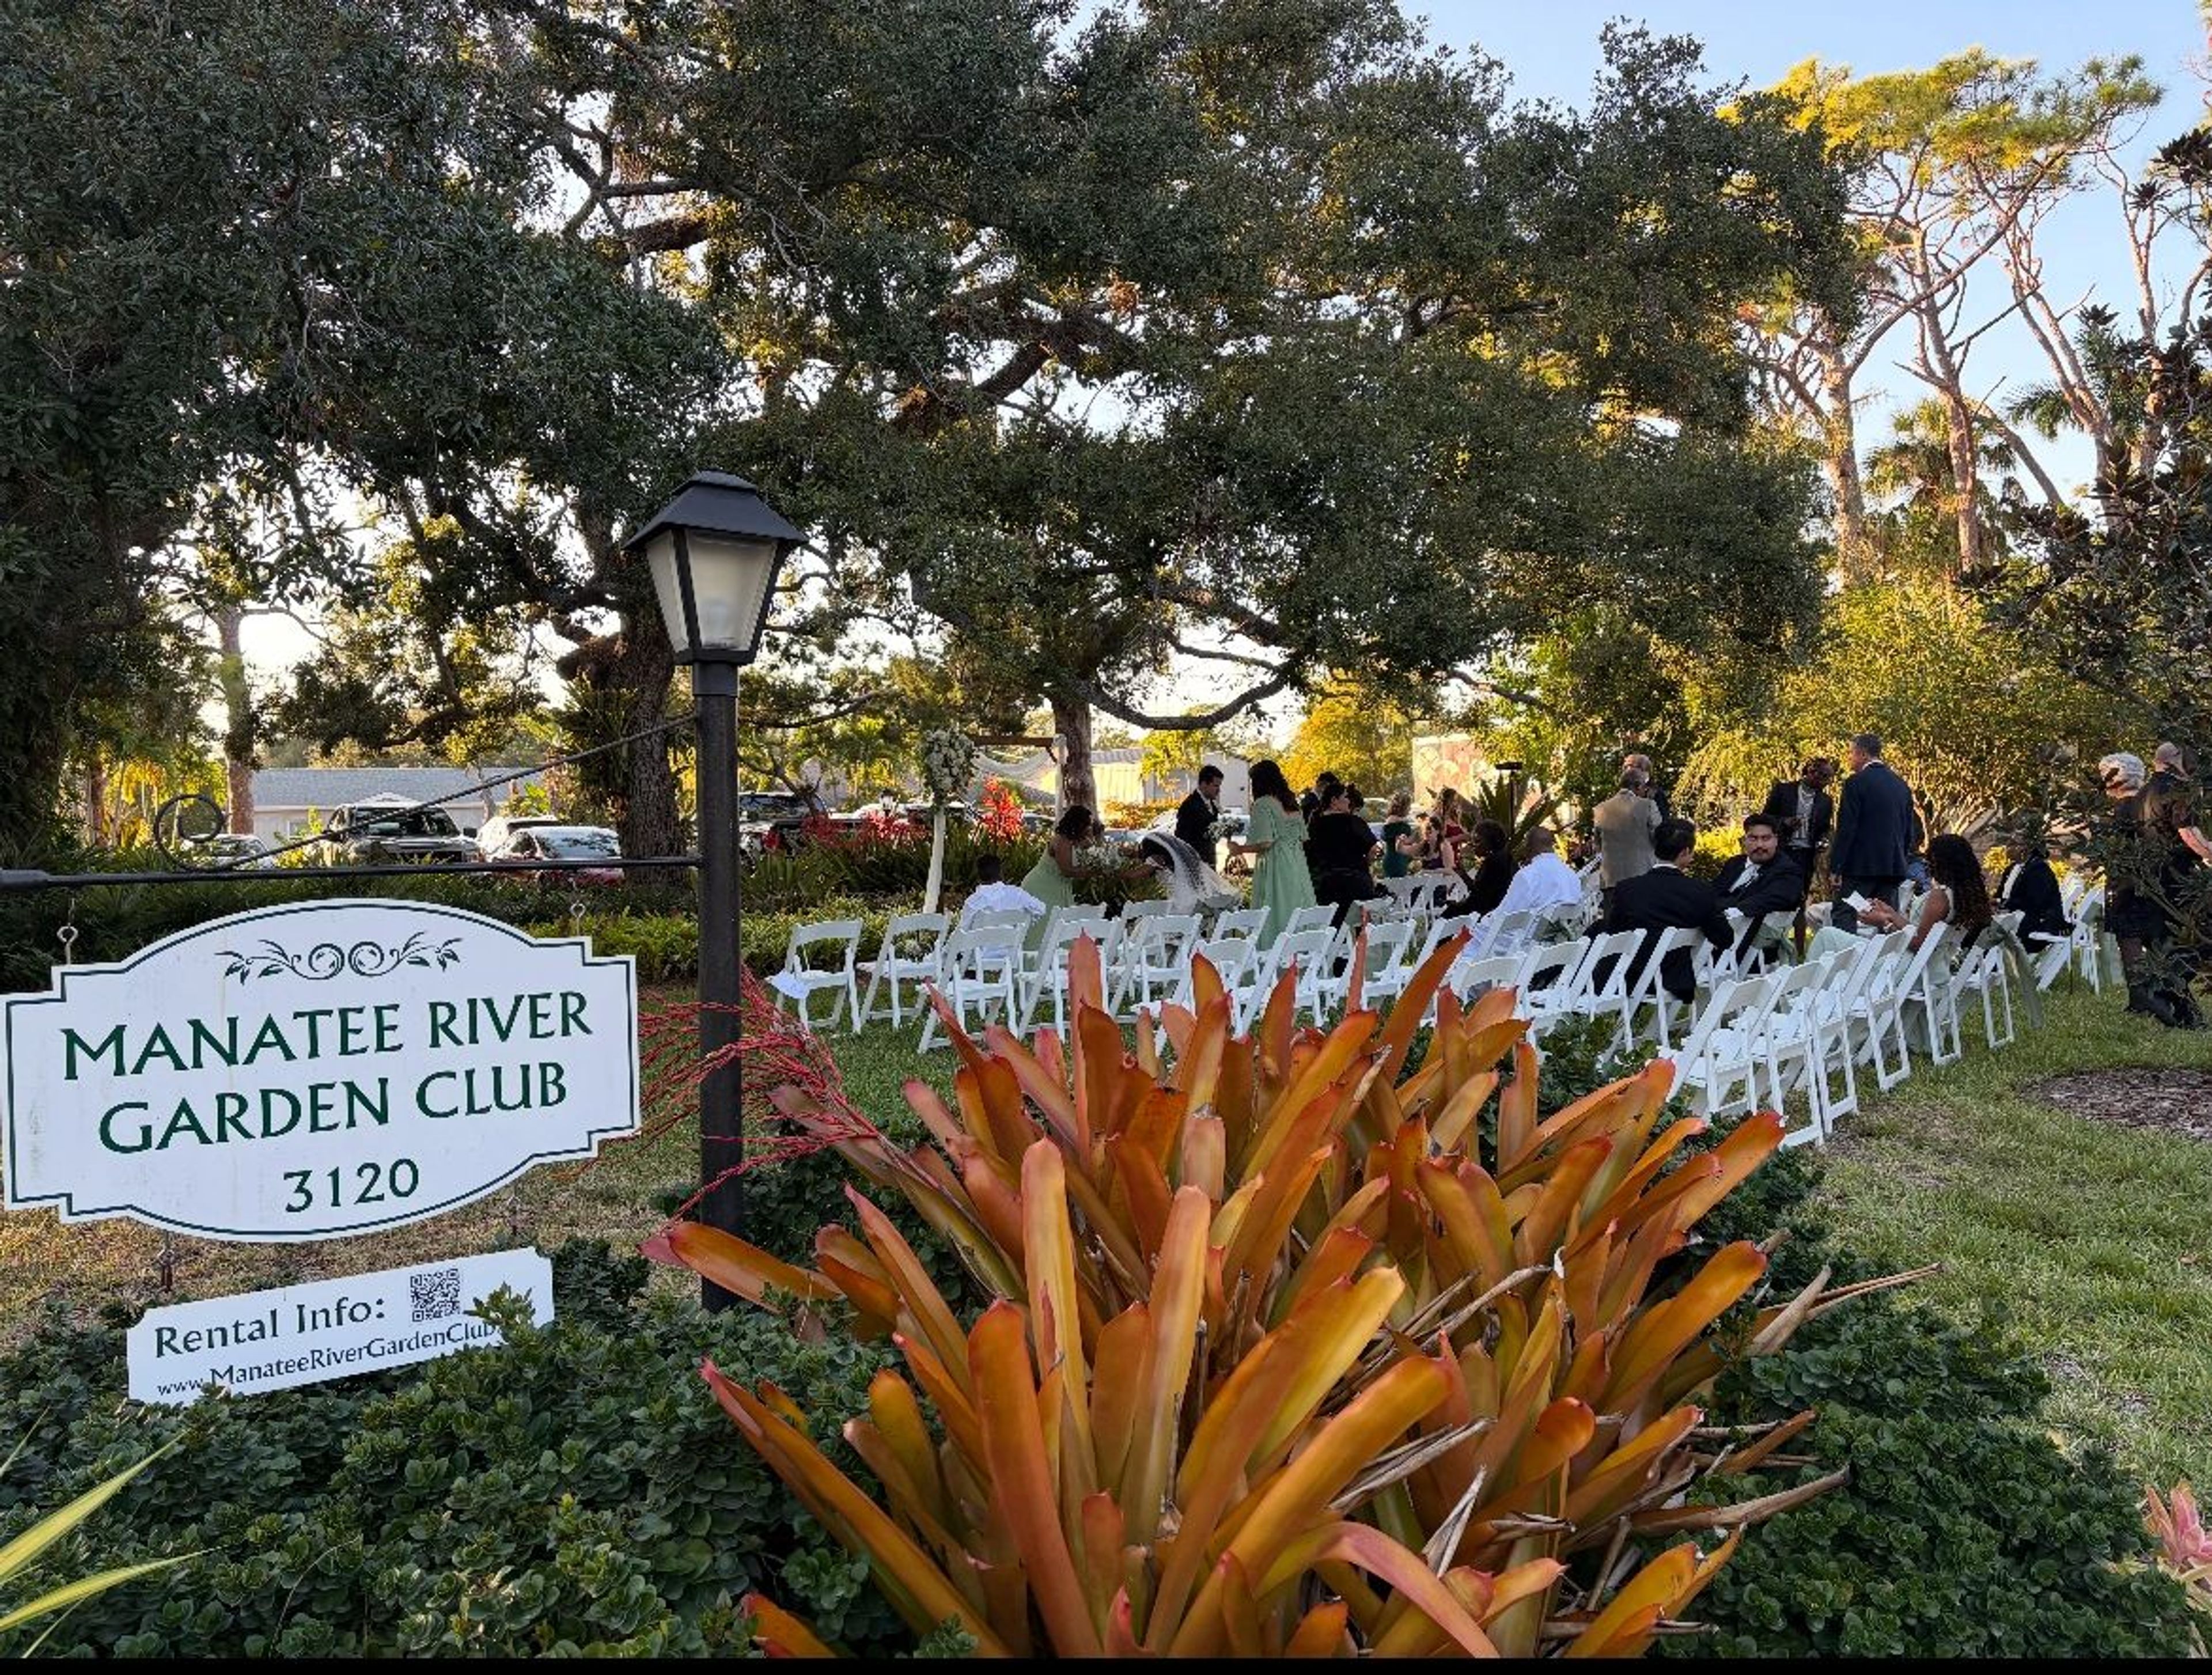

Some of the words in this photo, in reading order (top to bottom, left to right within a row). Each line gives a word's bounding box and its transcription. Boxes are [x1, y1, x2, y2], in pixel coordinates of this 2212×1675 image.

[61, 1004, 404, 1080] MANATEE
[429, 991, 593, 1048] RIVER
[100, 1078, 389, 1154] GARDEN
[416, 1063, 566, 1117] CLUB
[284, 1159, 419, 1212] 3120
[156, 1309, 279, 1358] Rental
[297, 1297, 385, 1333] Info:
